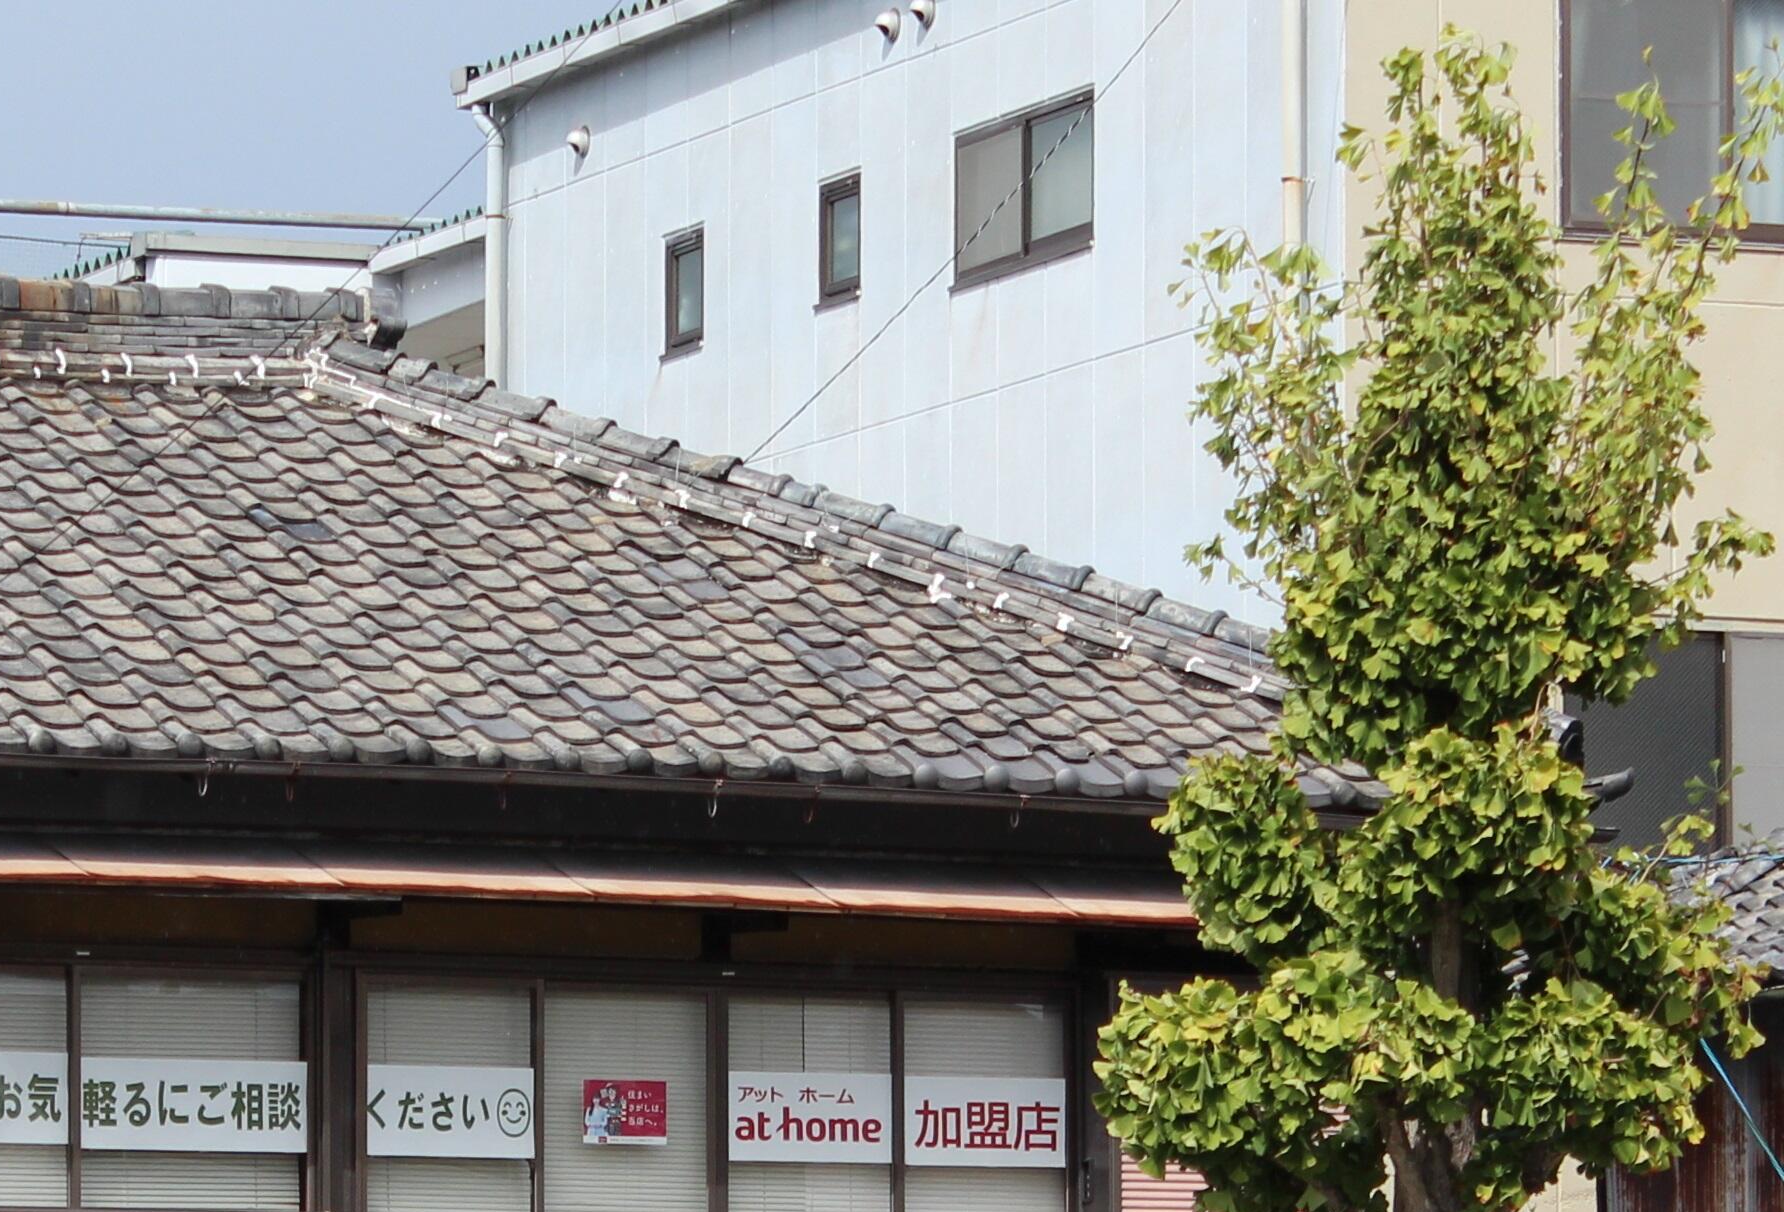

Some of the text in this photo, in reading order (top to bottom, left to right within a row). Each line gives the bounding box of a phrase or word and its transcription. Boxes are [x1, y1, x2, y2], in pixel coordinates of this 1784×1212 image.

[83, 1079, 301, 1131] 軽るにご相談
[366, 1088, 490, 1132] ください
[799, 1087, 855, 1104] ホーム
[914, 1100, 1061, 1152] 加盟店
